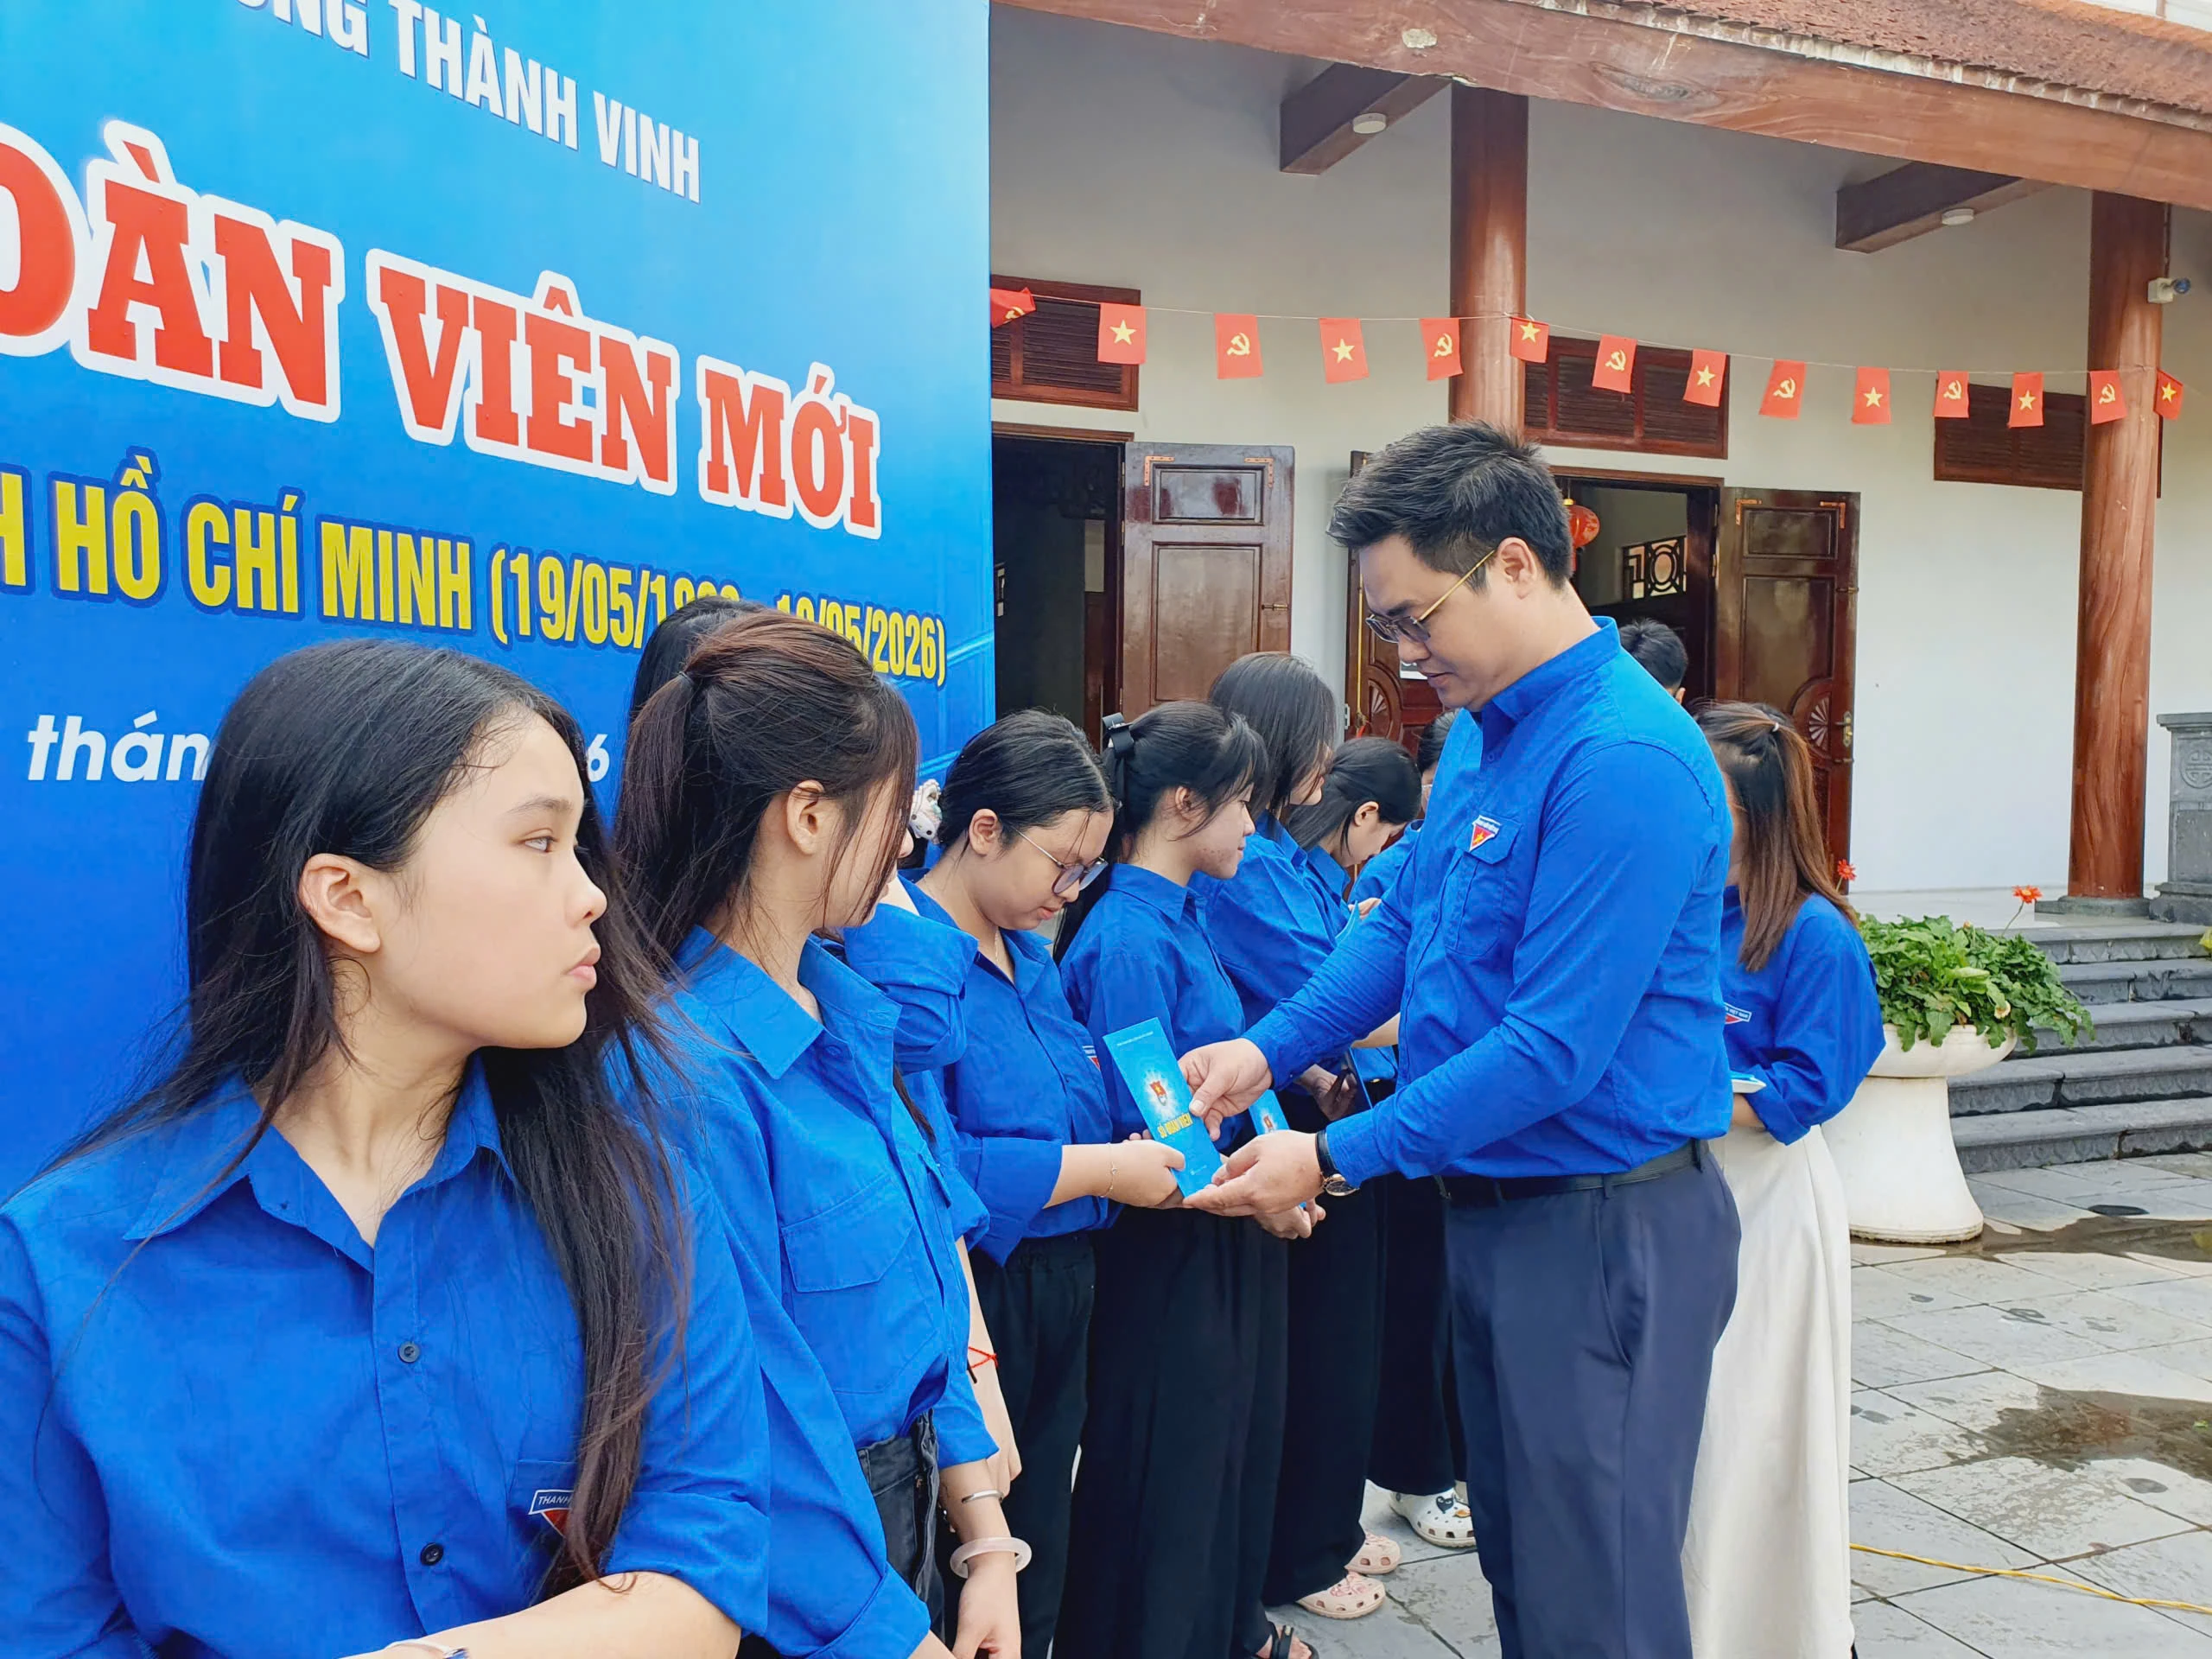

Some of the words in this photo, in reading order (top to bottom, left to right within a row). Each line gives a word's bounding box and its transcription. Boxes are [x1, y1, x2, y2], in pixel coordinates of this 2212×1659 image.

[388, 0, 578, 150] THÀNH
[593, 91, 702, 204] VINH
[378, 264, 673, 484] VIÊN
[704, 372, 876, 529] MỚI
[54, 454, 162, 601] HỒ
[186, 493, 300, 613] CHÍ
[321, 522, 473, 630] MINH
[490, 548, 740, 649] (19/05/1
[27, 709, 210, 782] thán
